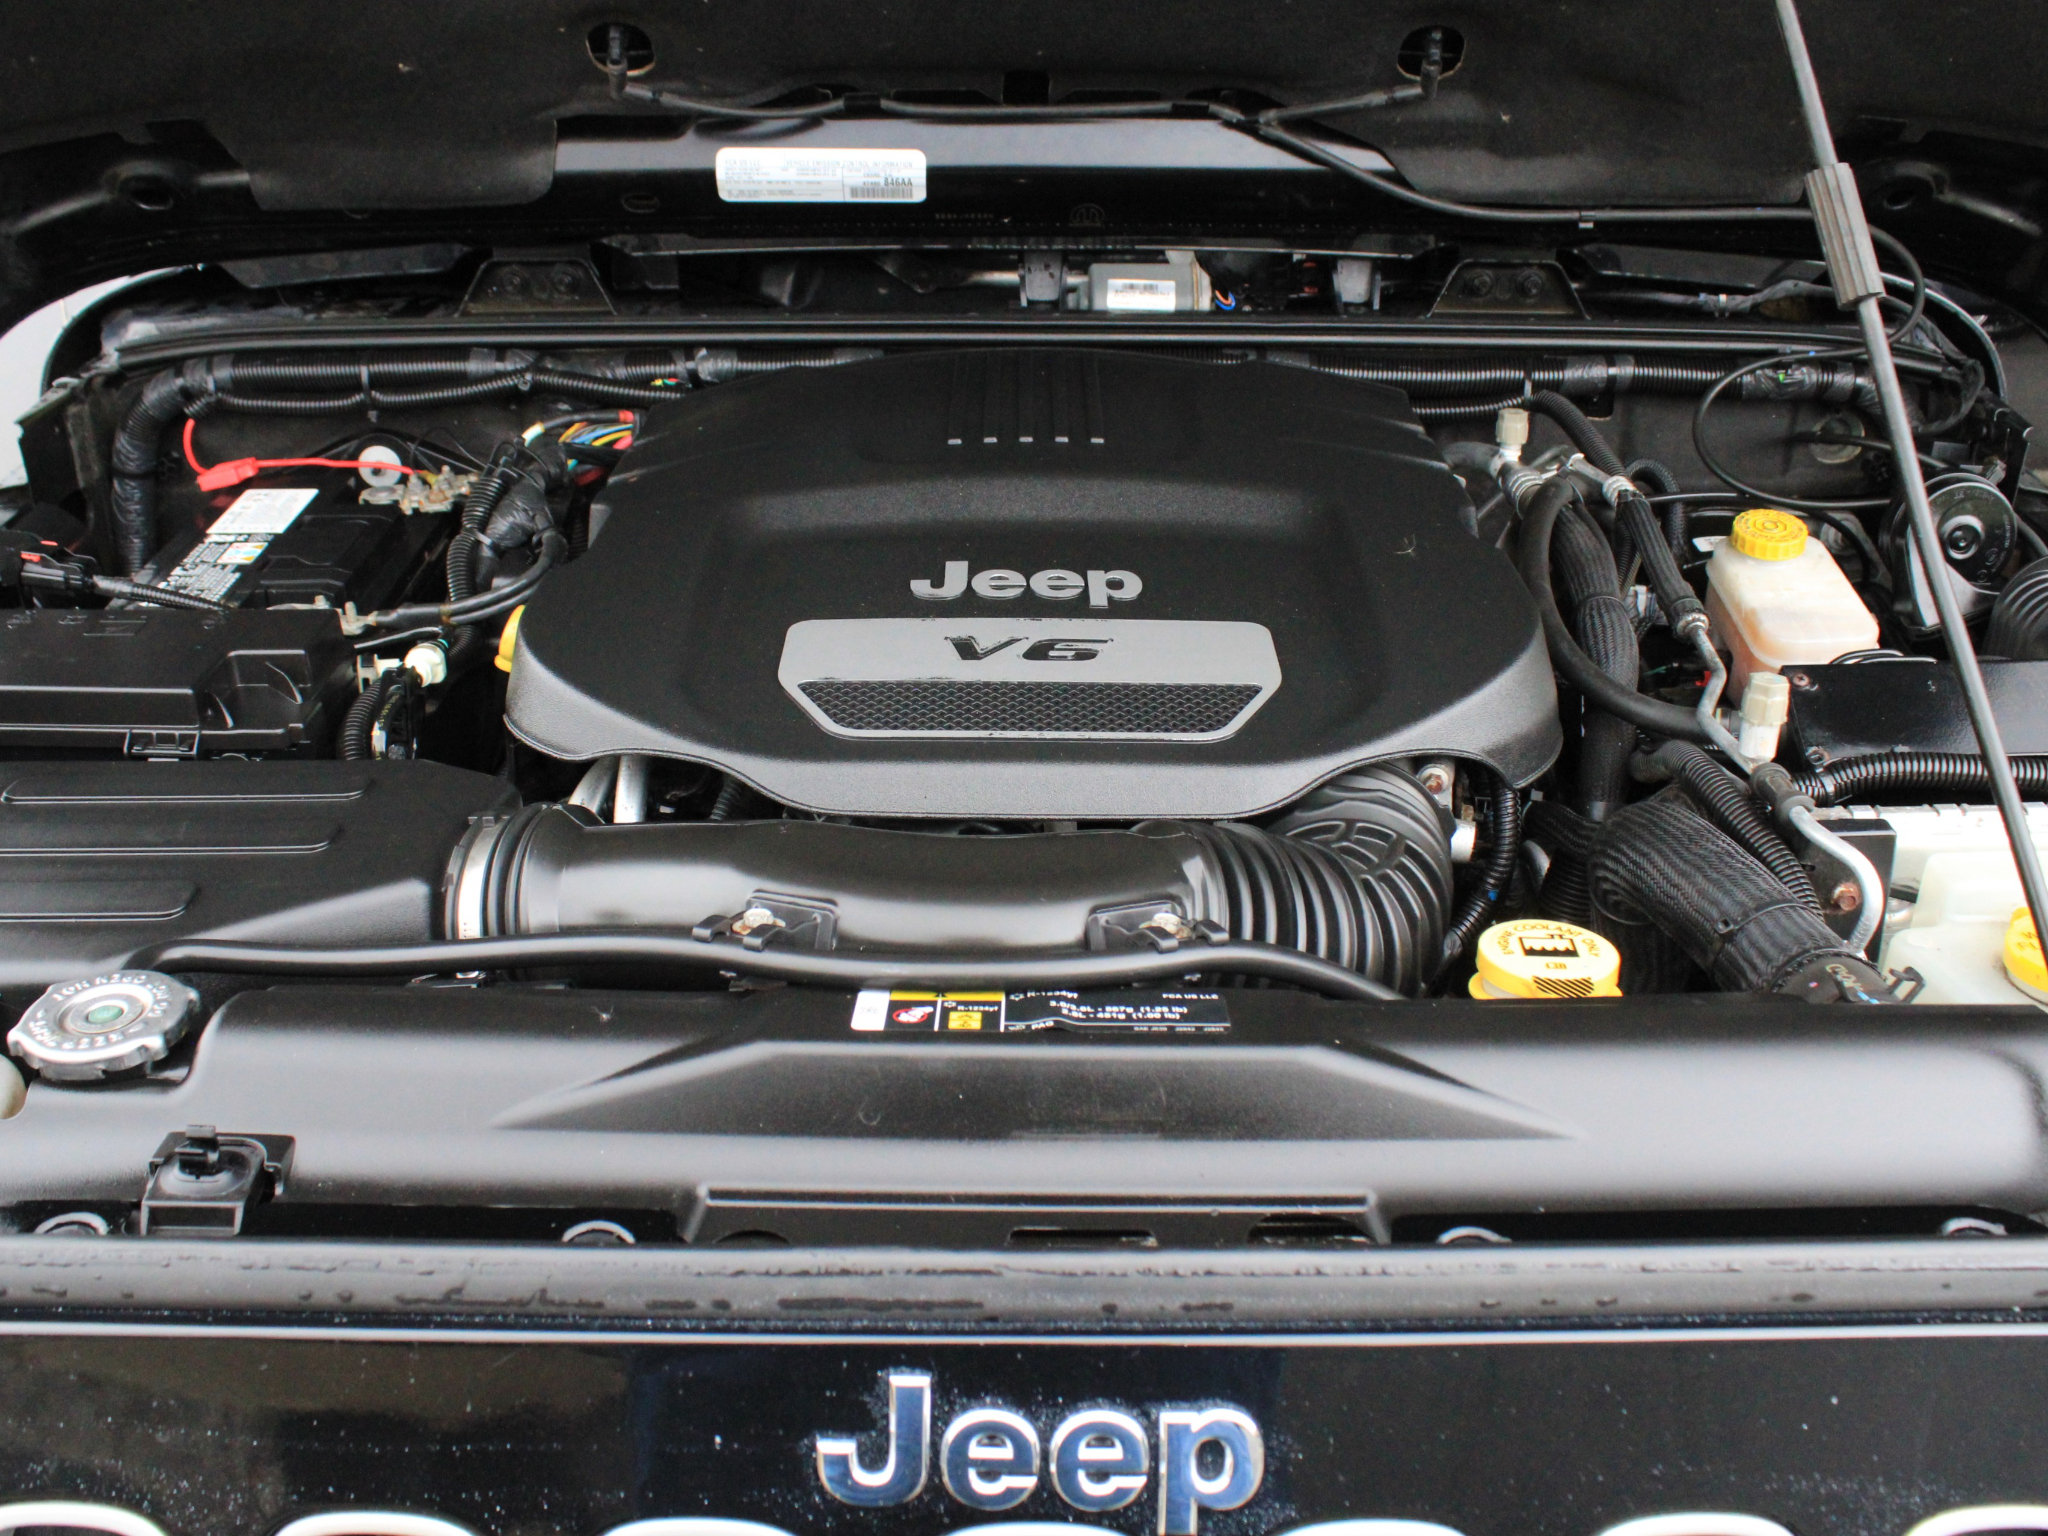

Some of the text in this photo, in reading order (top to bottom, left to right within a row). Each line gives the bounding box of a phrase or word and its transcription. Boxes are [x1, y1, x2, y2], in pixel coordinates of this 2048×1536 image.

[883, 177, 913, 187] 846AA
[910, 560, 1143, 608] Jeep
[944, 636, 1114, 662] V6
[1513, 922, 1583, 938] COOLANT
[1581, 937, 1601, 958] ONLY
[815, 1369, 1266, 1536] Jeep
